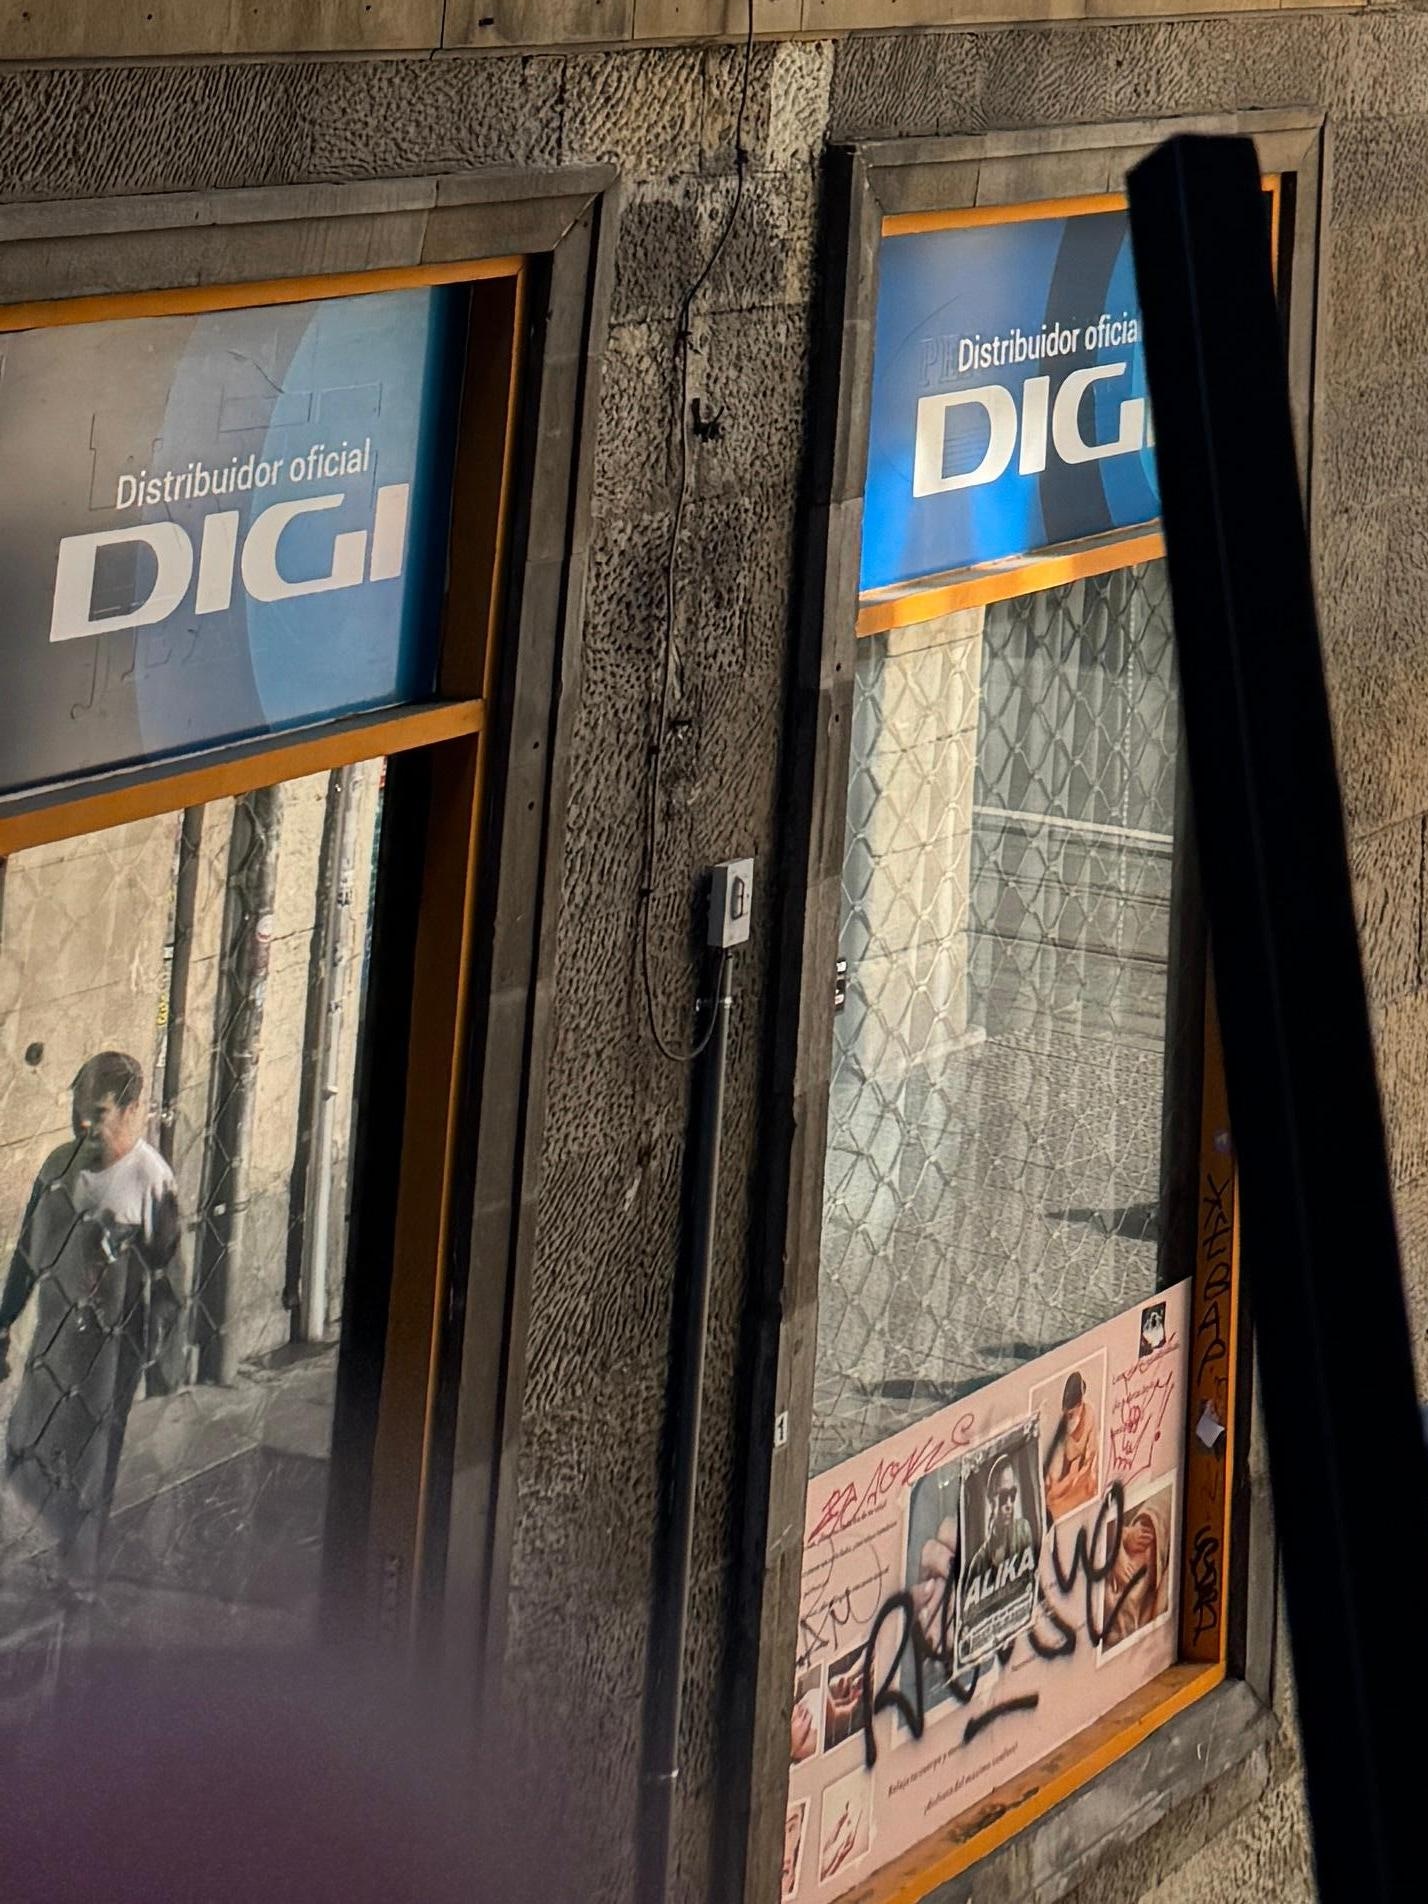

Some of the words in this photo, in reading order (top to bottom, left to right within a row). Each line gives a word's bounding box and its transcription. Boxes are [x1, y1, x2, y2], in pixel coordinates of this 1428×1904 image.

[958, 320, 1081, 373] Distribuidor
[1085, 310, 1142, 352] oficia
[911, 361, 1156, 500] DIG
[115, 454, 284, 510] Distribuidor
[289, 435, 372, 482] oficial
[48, 482, 410, 643] DIGI
[963, 1545, 1036, 1613] ALIKA
